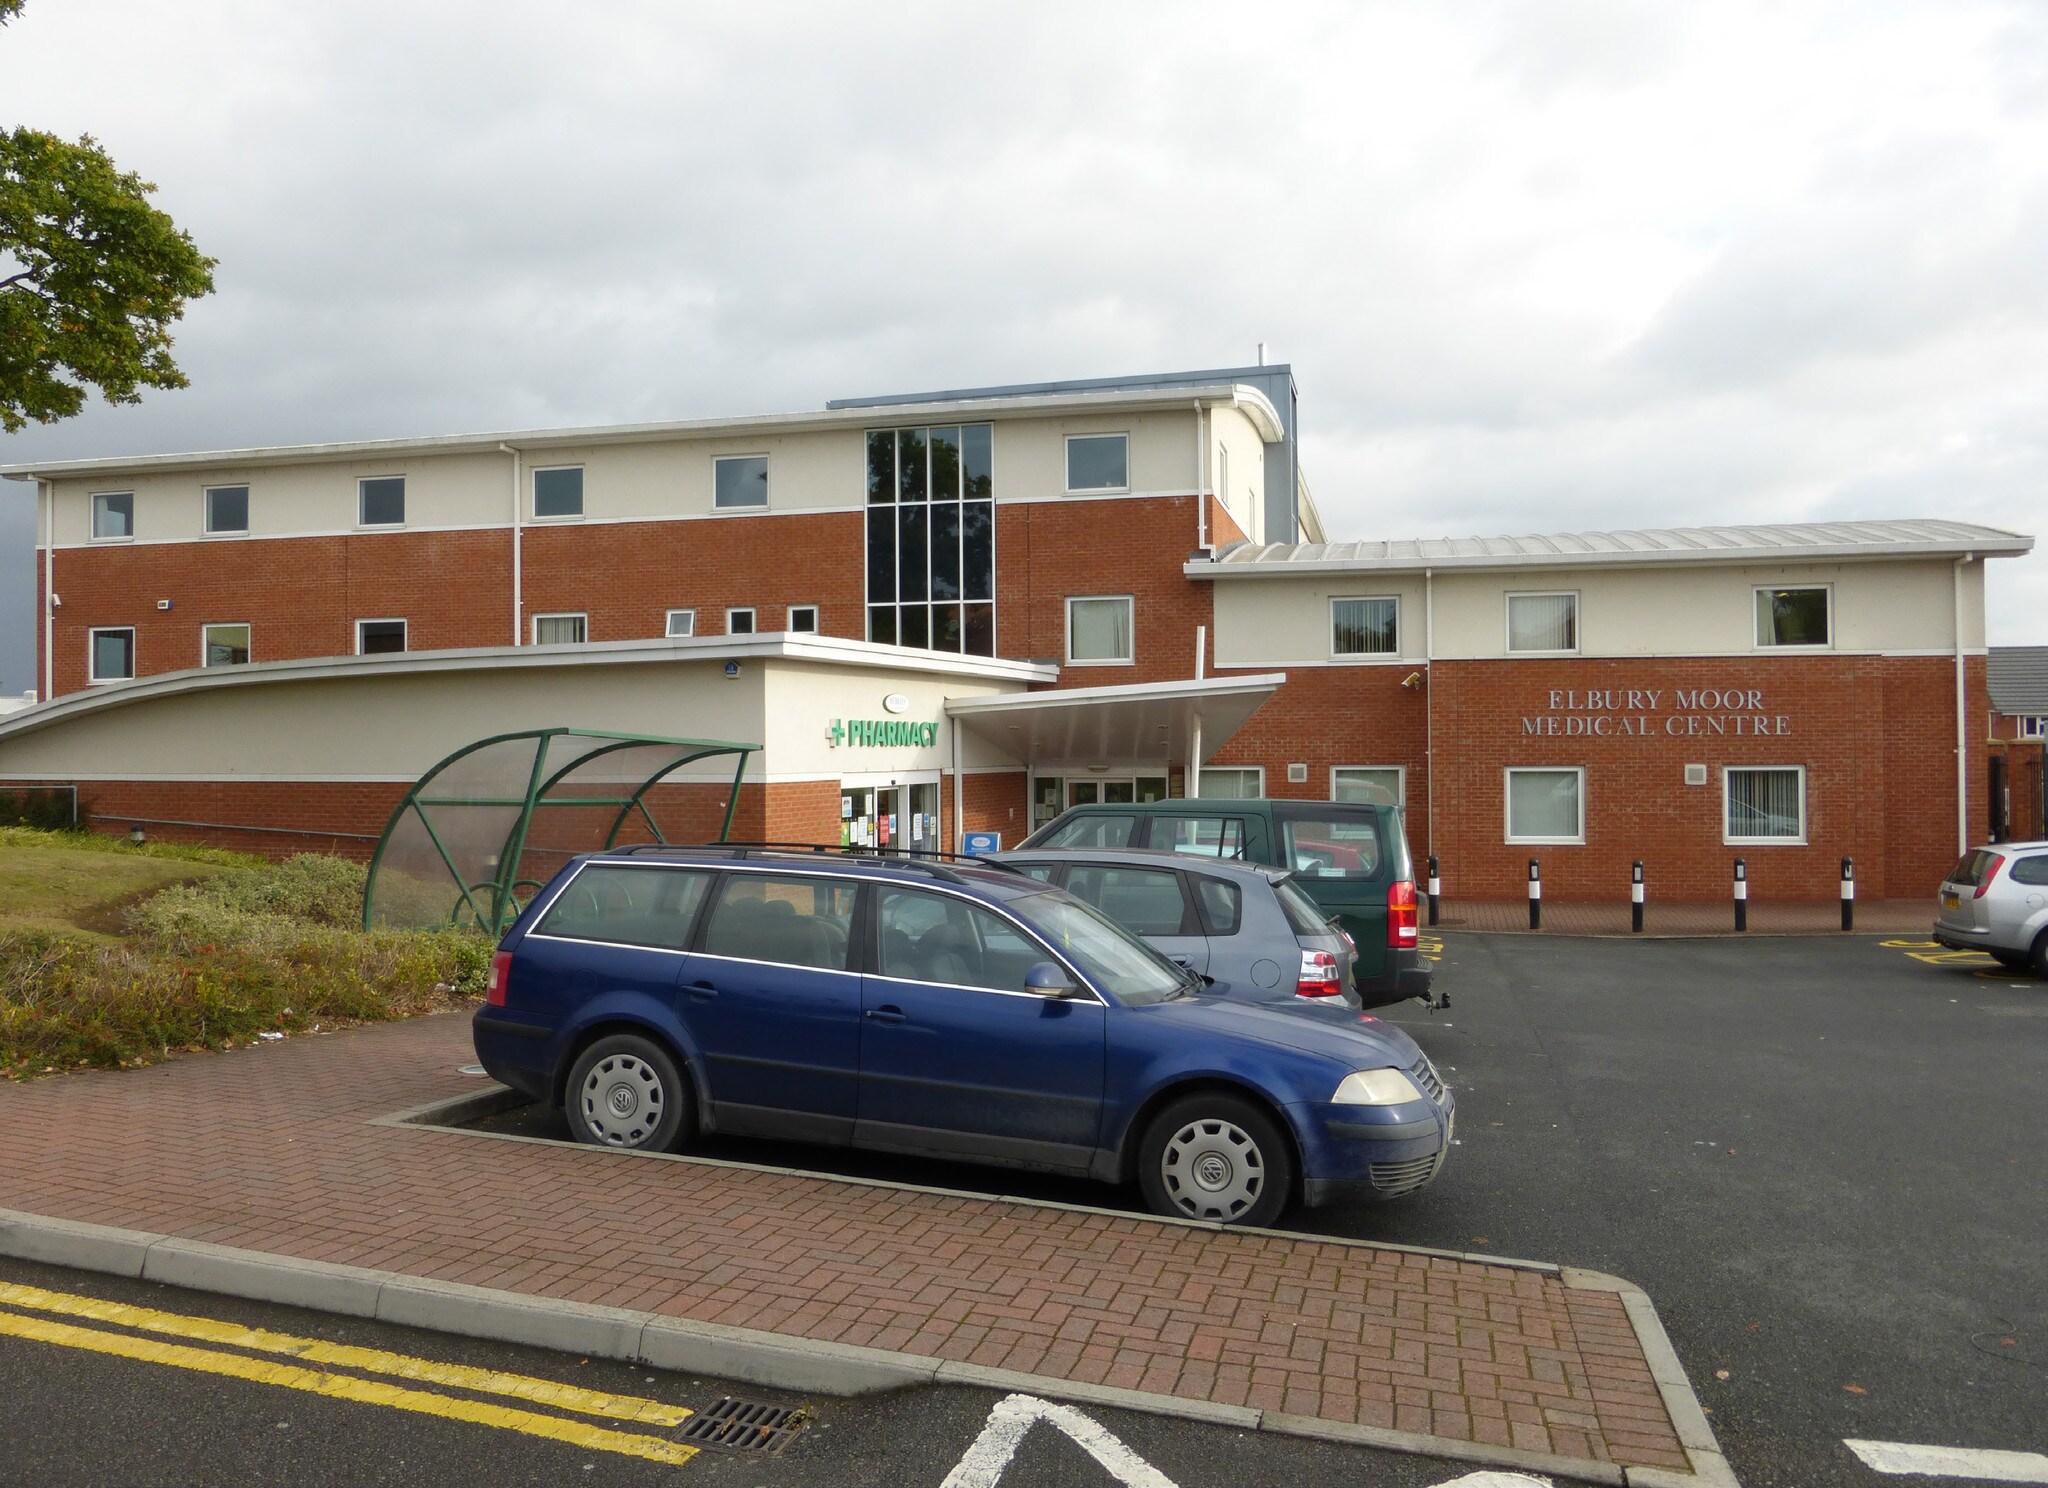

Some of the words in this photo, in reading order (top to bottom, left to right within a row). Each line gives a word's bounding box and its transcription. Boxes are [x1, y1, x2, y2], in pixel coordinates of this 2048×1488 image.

[1548, 689, 1663, 711] ELBURY
[1675, 689, 1765, 711] MOOR
[847, 719, 940, 748] PHARMACY
[1520, 715, 1656, 737] MEDICAL
[1665, 715, 1792, 737] CENTRE
